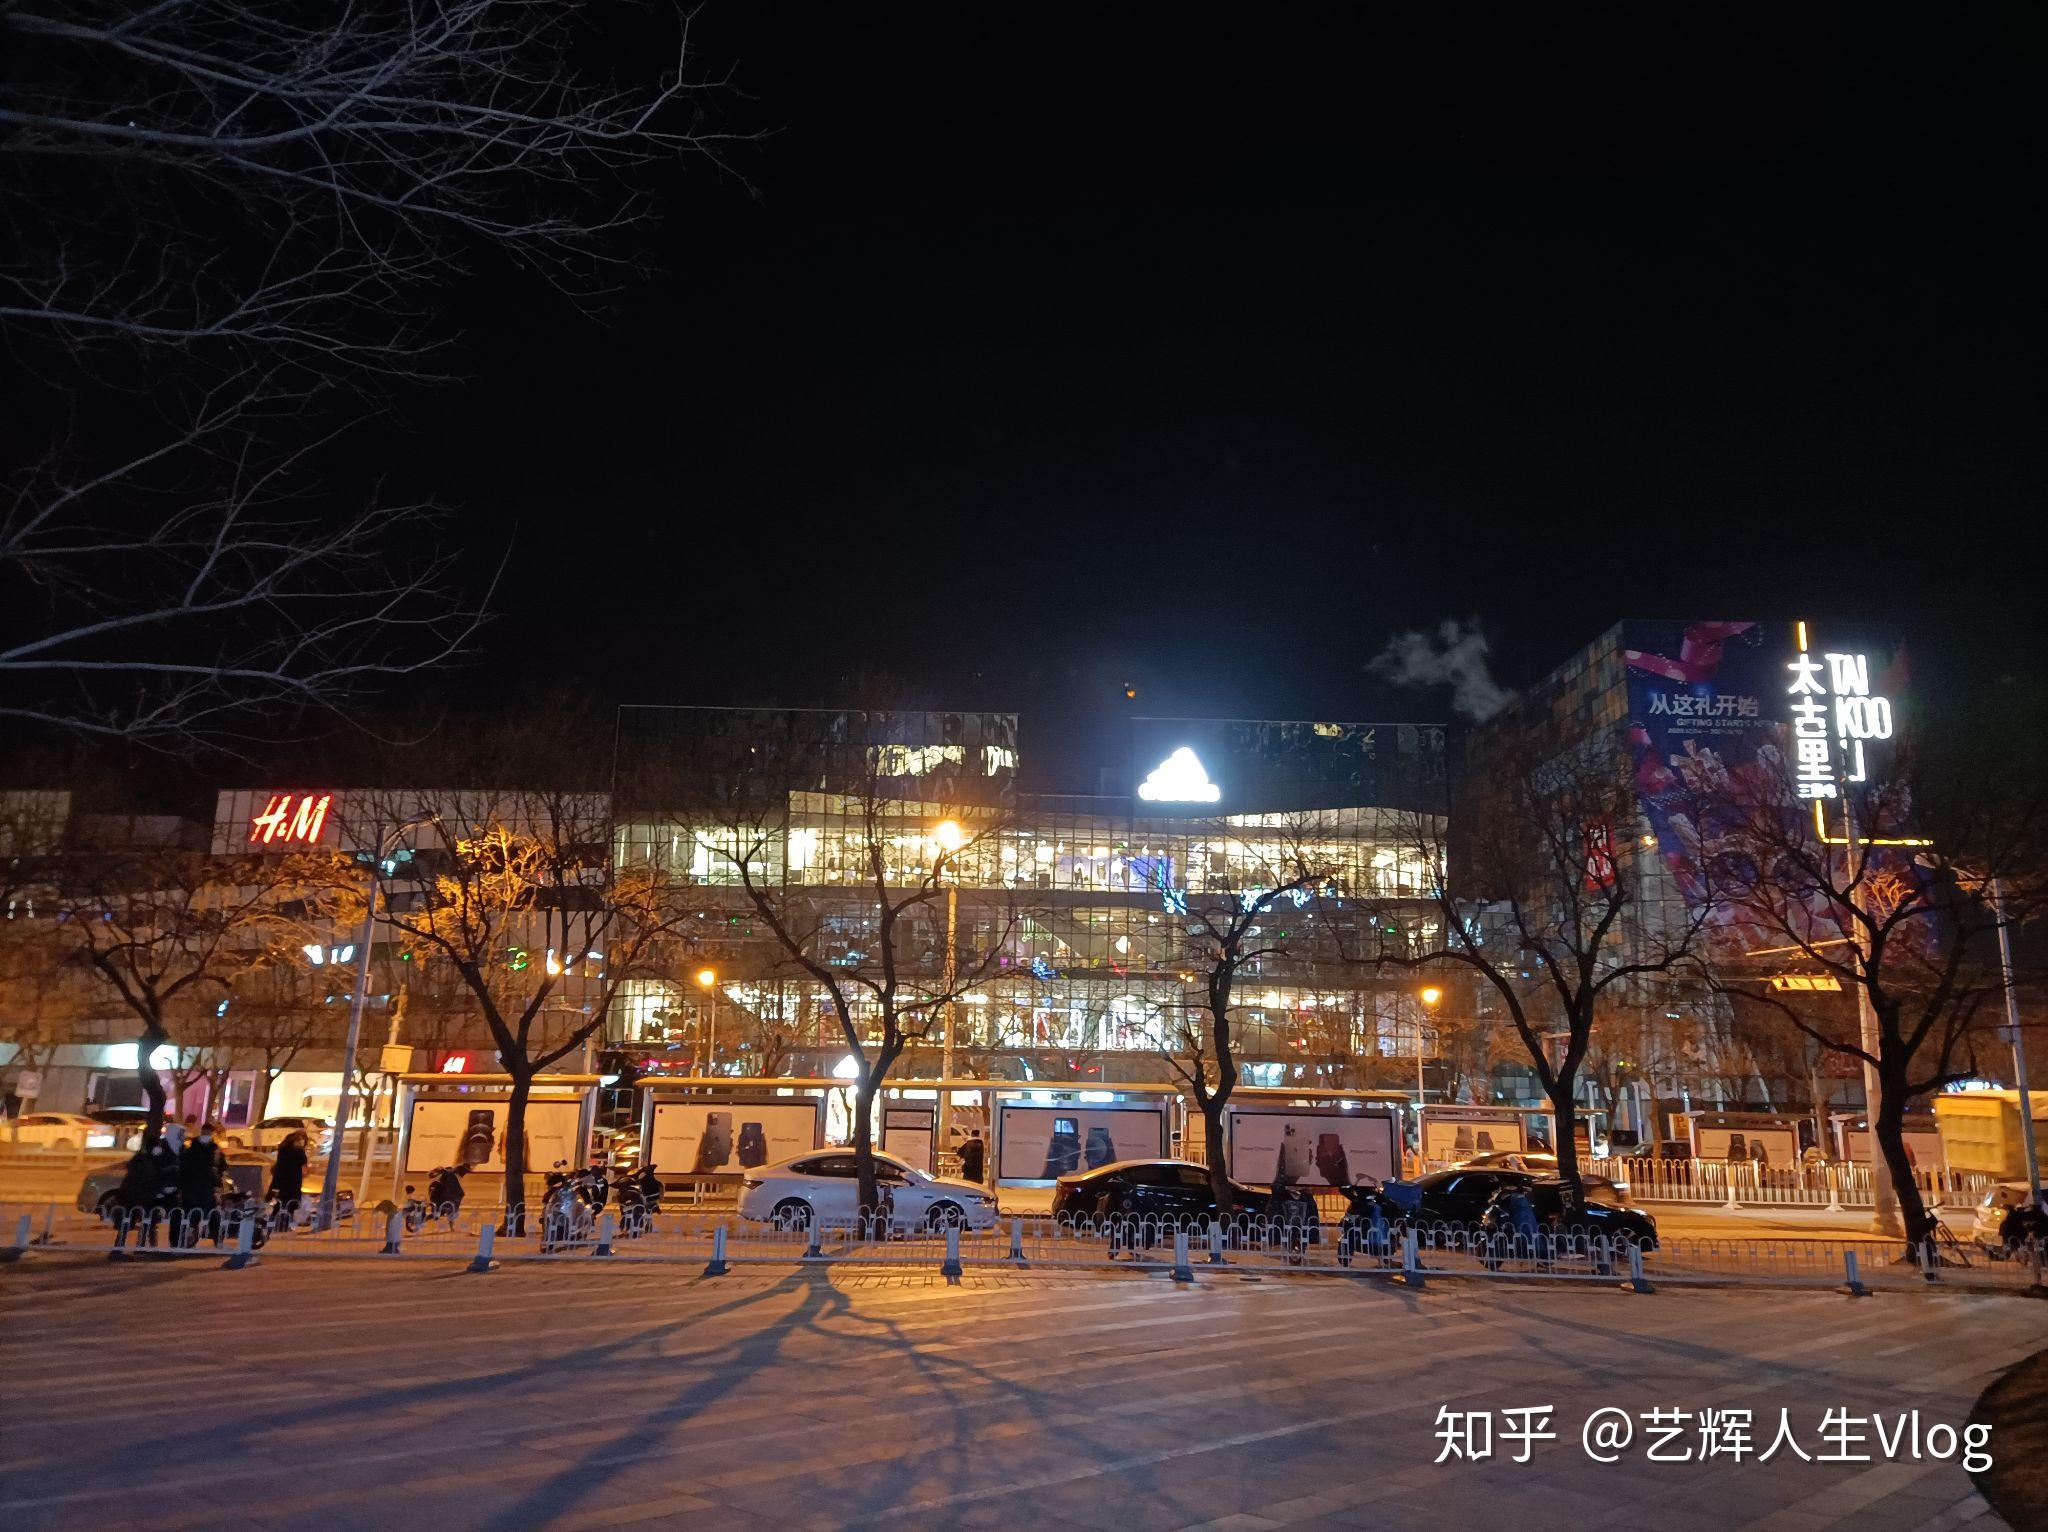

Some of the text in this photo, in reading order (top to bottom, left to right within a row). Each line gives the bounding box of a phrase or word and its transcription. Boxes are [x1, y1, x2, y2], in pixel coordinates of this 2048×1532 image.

[1649, 693, 1759, 716] 从这礼开始
[1835, 696, 1893, 740] KOO
[250, 795, 331, 844] H&M
